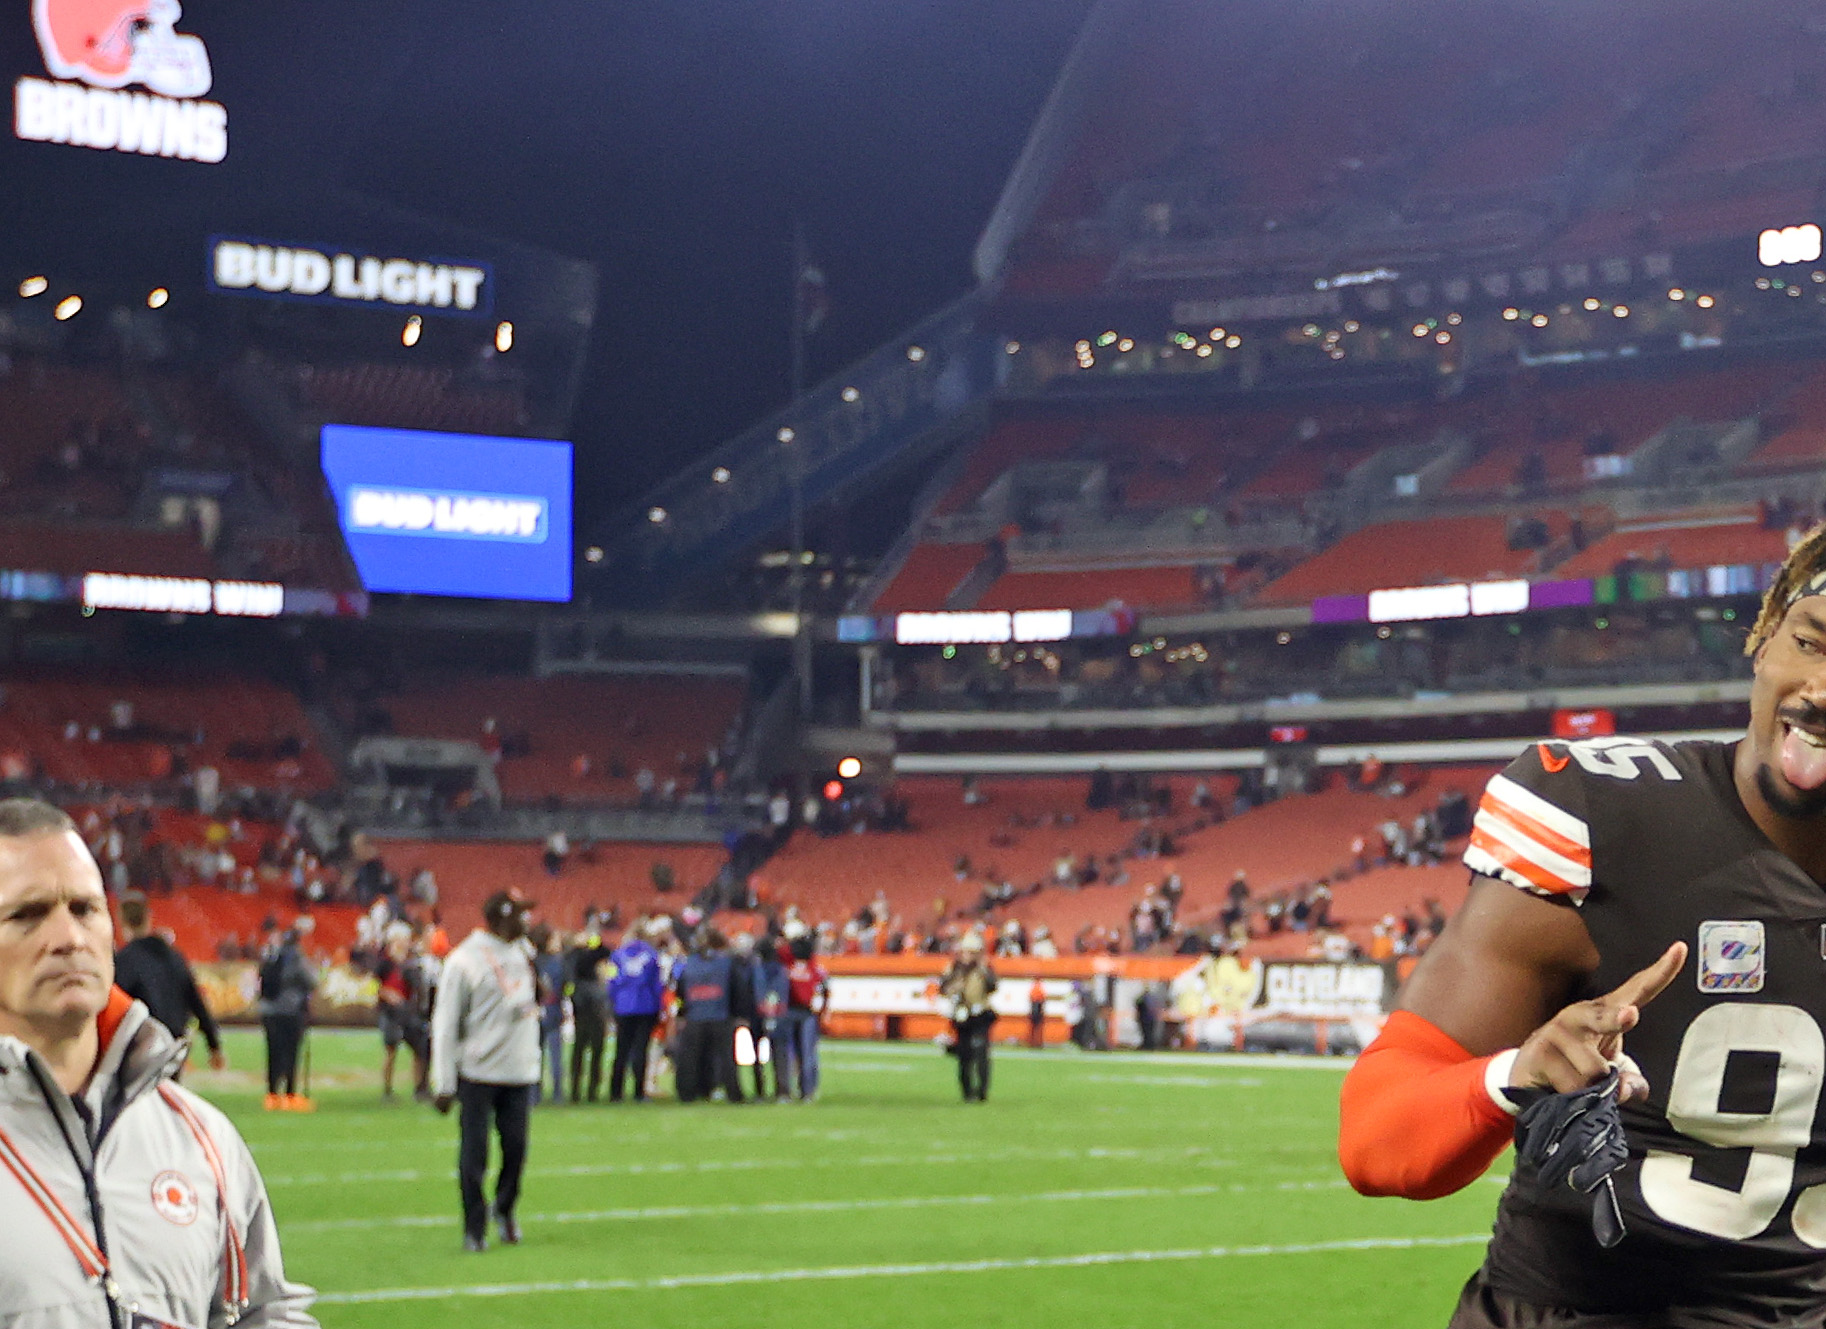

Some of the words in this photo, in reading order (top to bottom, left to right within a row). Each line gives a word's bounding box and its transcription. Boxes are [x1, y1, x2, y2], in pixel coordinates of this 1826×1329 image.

[15, 75, 228, 164] BROWNS
[214, 240, 331, 295] BUD
[332, 253, 485, 311] LIGHT
[354, 491, 433, 530] BUD
[433, 496, 542, 538] LIGHT
